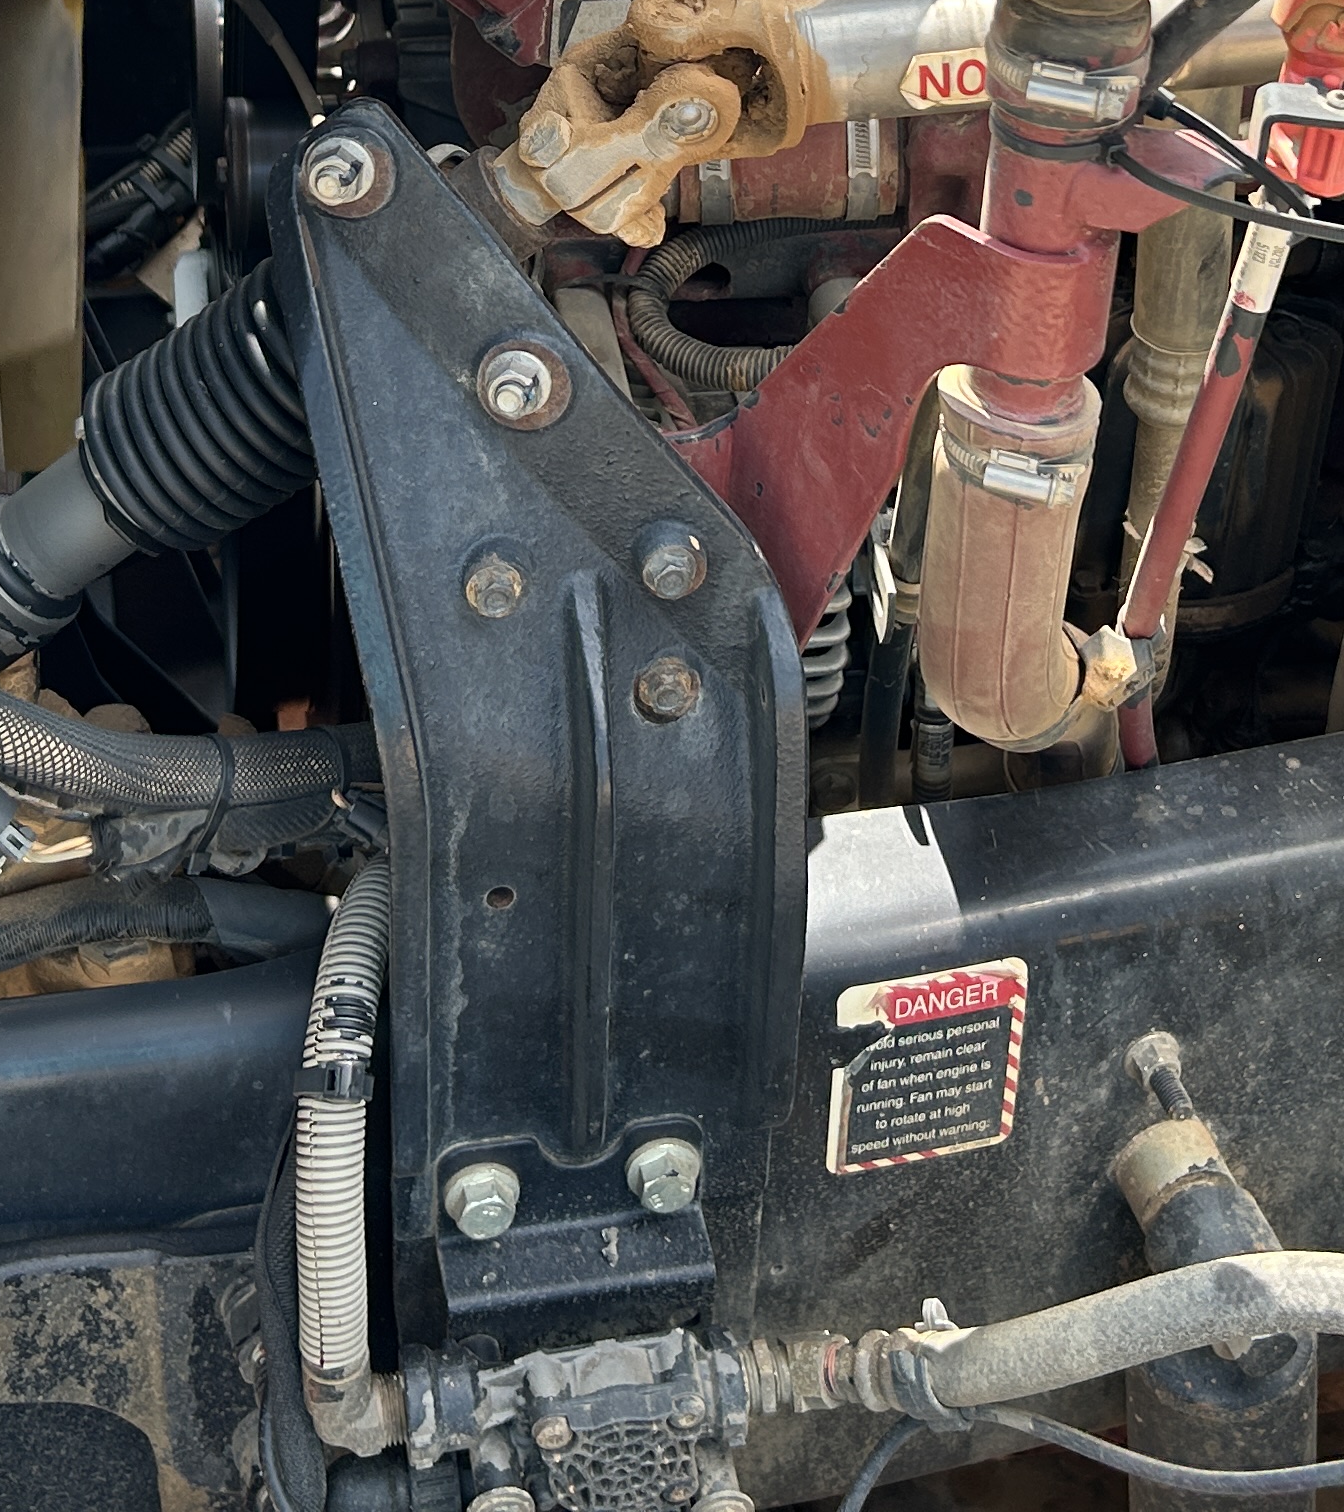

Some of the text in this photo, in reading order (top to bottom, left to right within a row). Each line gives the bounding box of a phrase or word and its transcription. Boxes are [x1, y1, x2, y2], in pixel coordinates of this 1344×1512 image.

[918, 58, 987, 101] NO
[895, 981, 999, 1019] DANGER
[897, 1029, 944, 1047] serious
[946, 1016, 1000, 1040] personal
[909, 1047, 954, 1065] remain
[955, 1040, 987, 1057] clear
[861, 1059, 992, 1093] of fan when engine is
[856, 1078, 993, 1113] running. Fan may start
[875, 1102, 971, 1130] to rotate at high
[850, 1136, 890, 1155] speed
[892, 1128, 936, 1146] without
